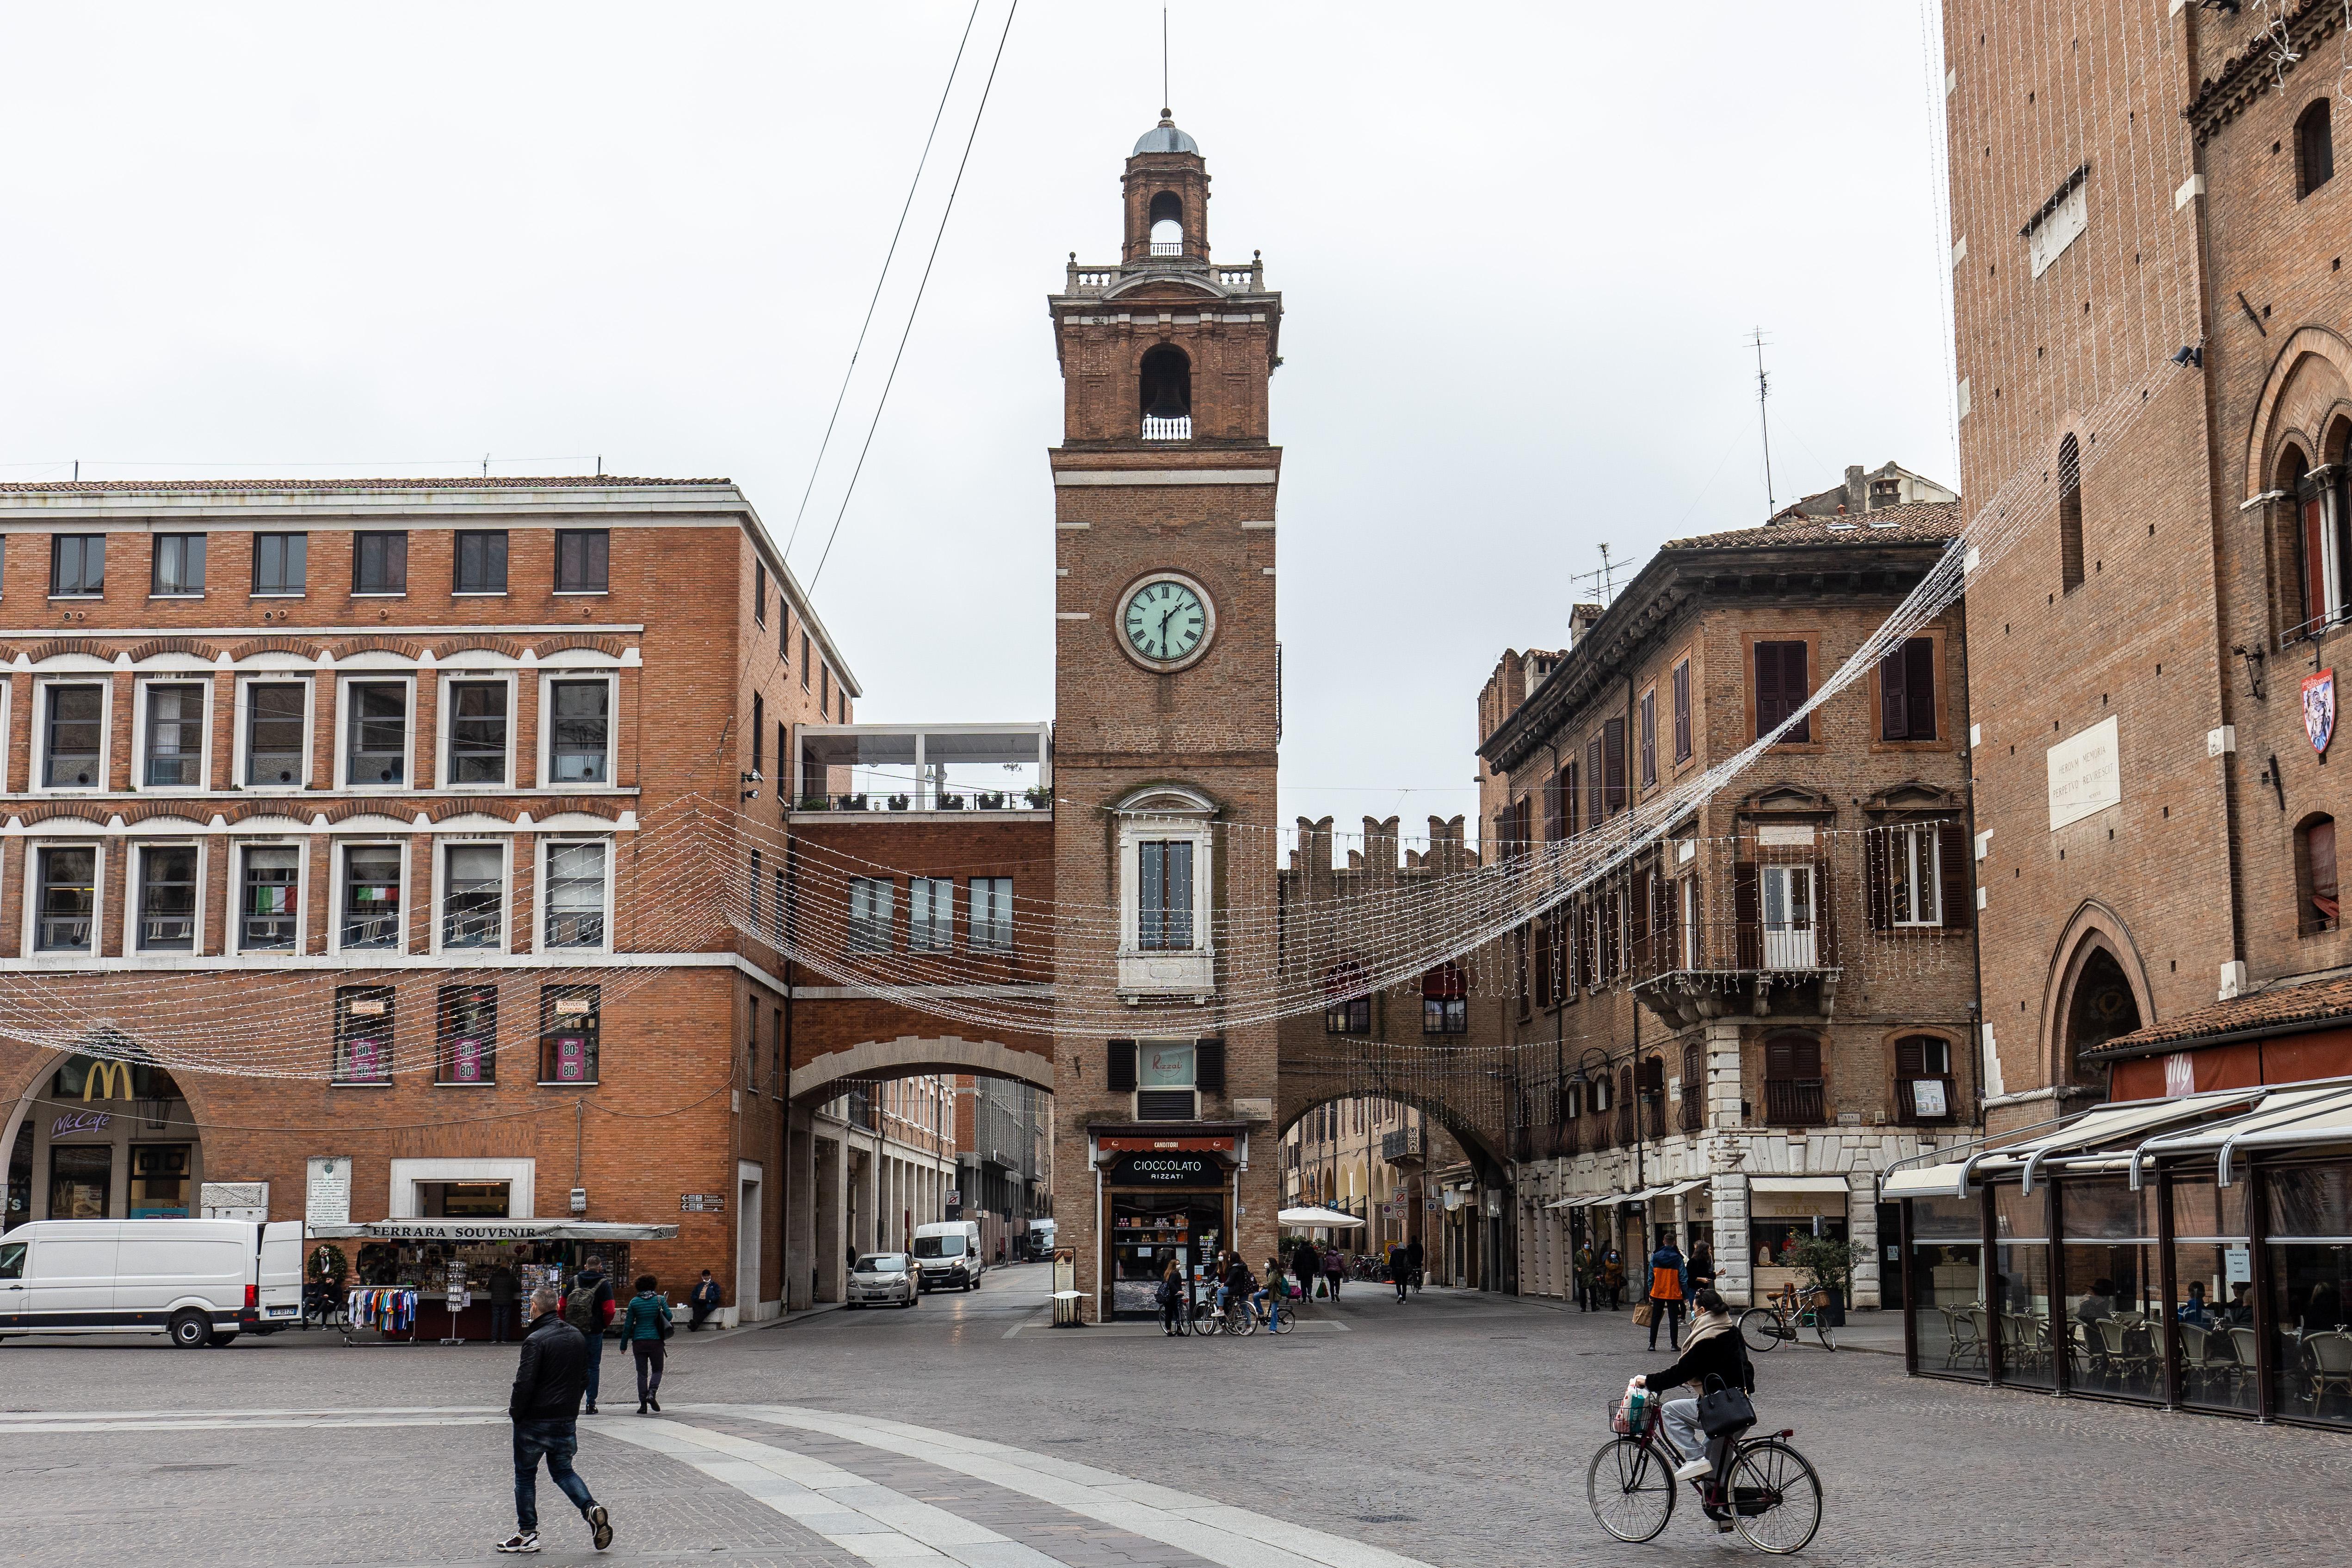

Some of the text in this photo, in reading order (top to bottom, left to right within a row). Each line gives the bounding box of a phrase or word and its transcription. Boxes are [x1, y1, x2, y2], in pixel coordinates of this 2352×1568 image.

[2083, 746, 2106, 763] MEMORIA
[2167, 1052, 2191, 1091] illy
[51, 1109, 111, 1134] McCafé
[1134, 1161, 1201, 1171] CIOCCOLATO
[1774, 1205, 1822, 1215] ROLEX
[1661, 1212, 1673, 1221] TUDOR
[372, 1227, 447, 1237] FERRARA
[455, 1228, 537, 1237] SOUVENIR
